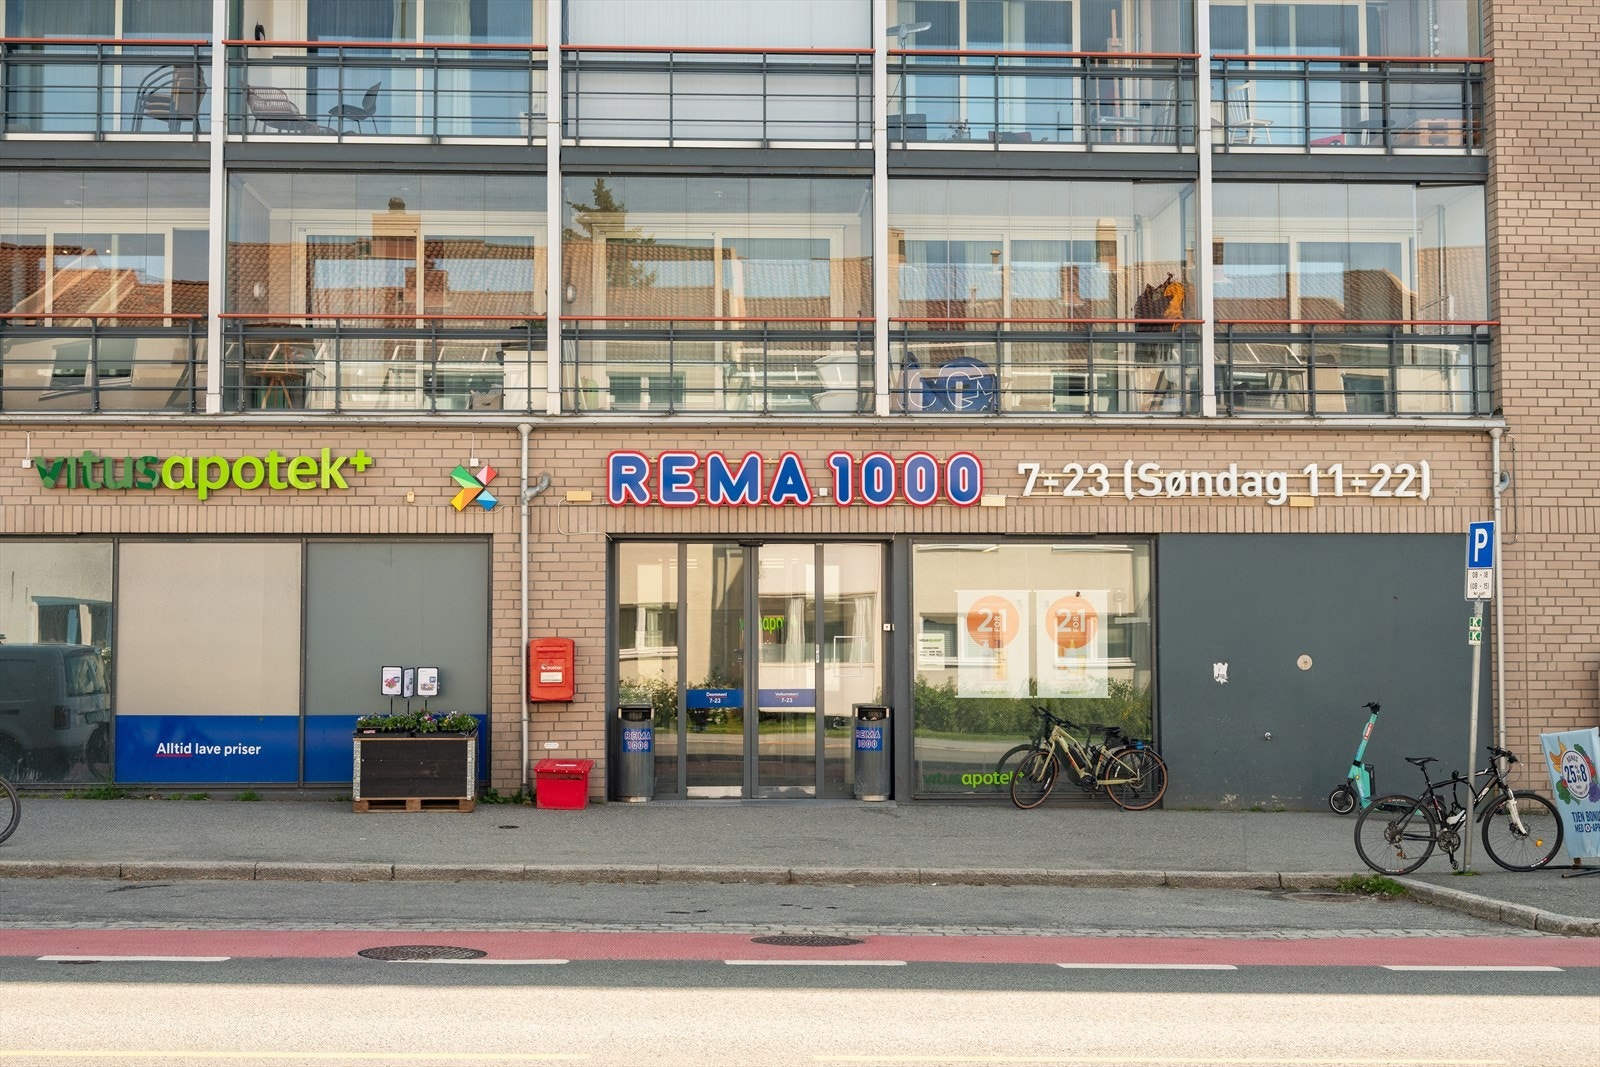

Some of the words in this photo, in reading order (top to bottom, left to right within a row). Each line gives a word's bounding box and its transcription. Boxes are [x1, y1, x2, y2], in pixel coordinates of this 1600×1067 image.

[607, 451, 813, 507] REMA
[827, 451, 983, 507] 1000
[1017, 463, 1110, 498] 7-23
[1124, 459, 1288, 505] (Søndag
[1302, 459, 1430, 501] 11-22)
[1474, 527, 1488, 562] P
[977, 608, 994, 633] 2
[999, 608, 1007, 633] 1
[1056, 608, 1072, 633] 2
[1078, 608, 1086, 633] 1
[624, 731, 651, 740] REMA
[627, 740, 649, 750] 1000
[156, 742, 192, 755] Alltid
[195, 742, 221, 755] lave
[224, 743, 262, 757] priser
[1564, 765, 1577, 783] 25
[1580, 764, 1588, 782] 8
